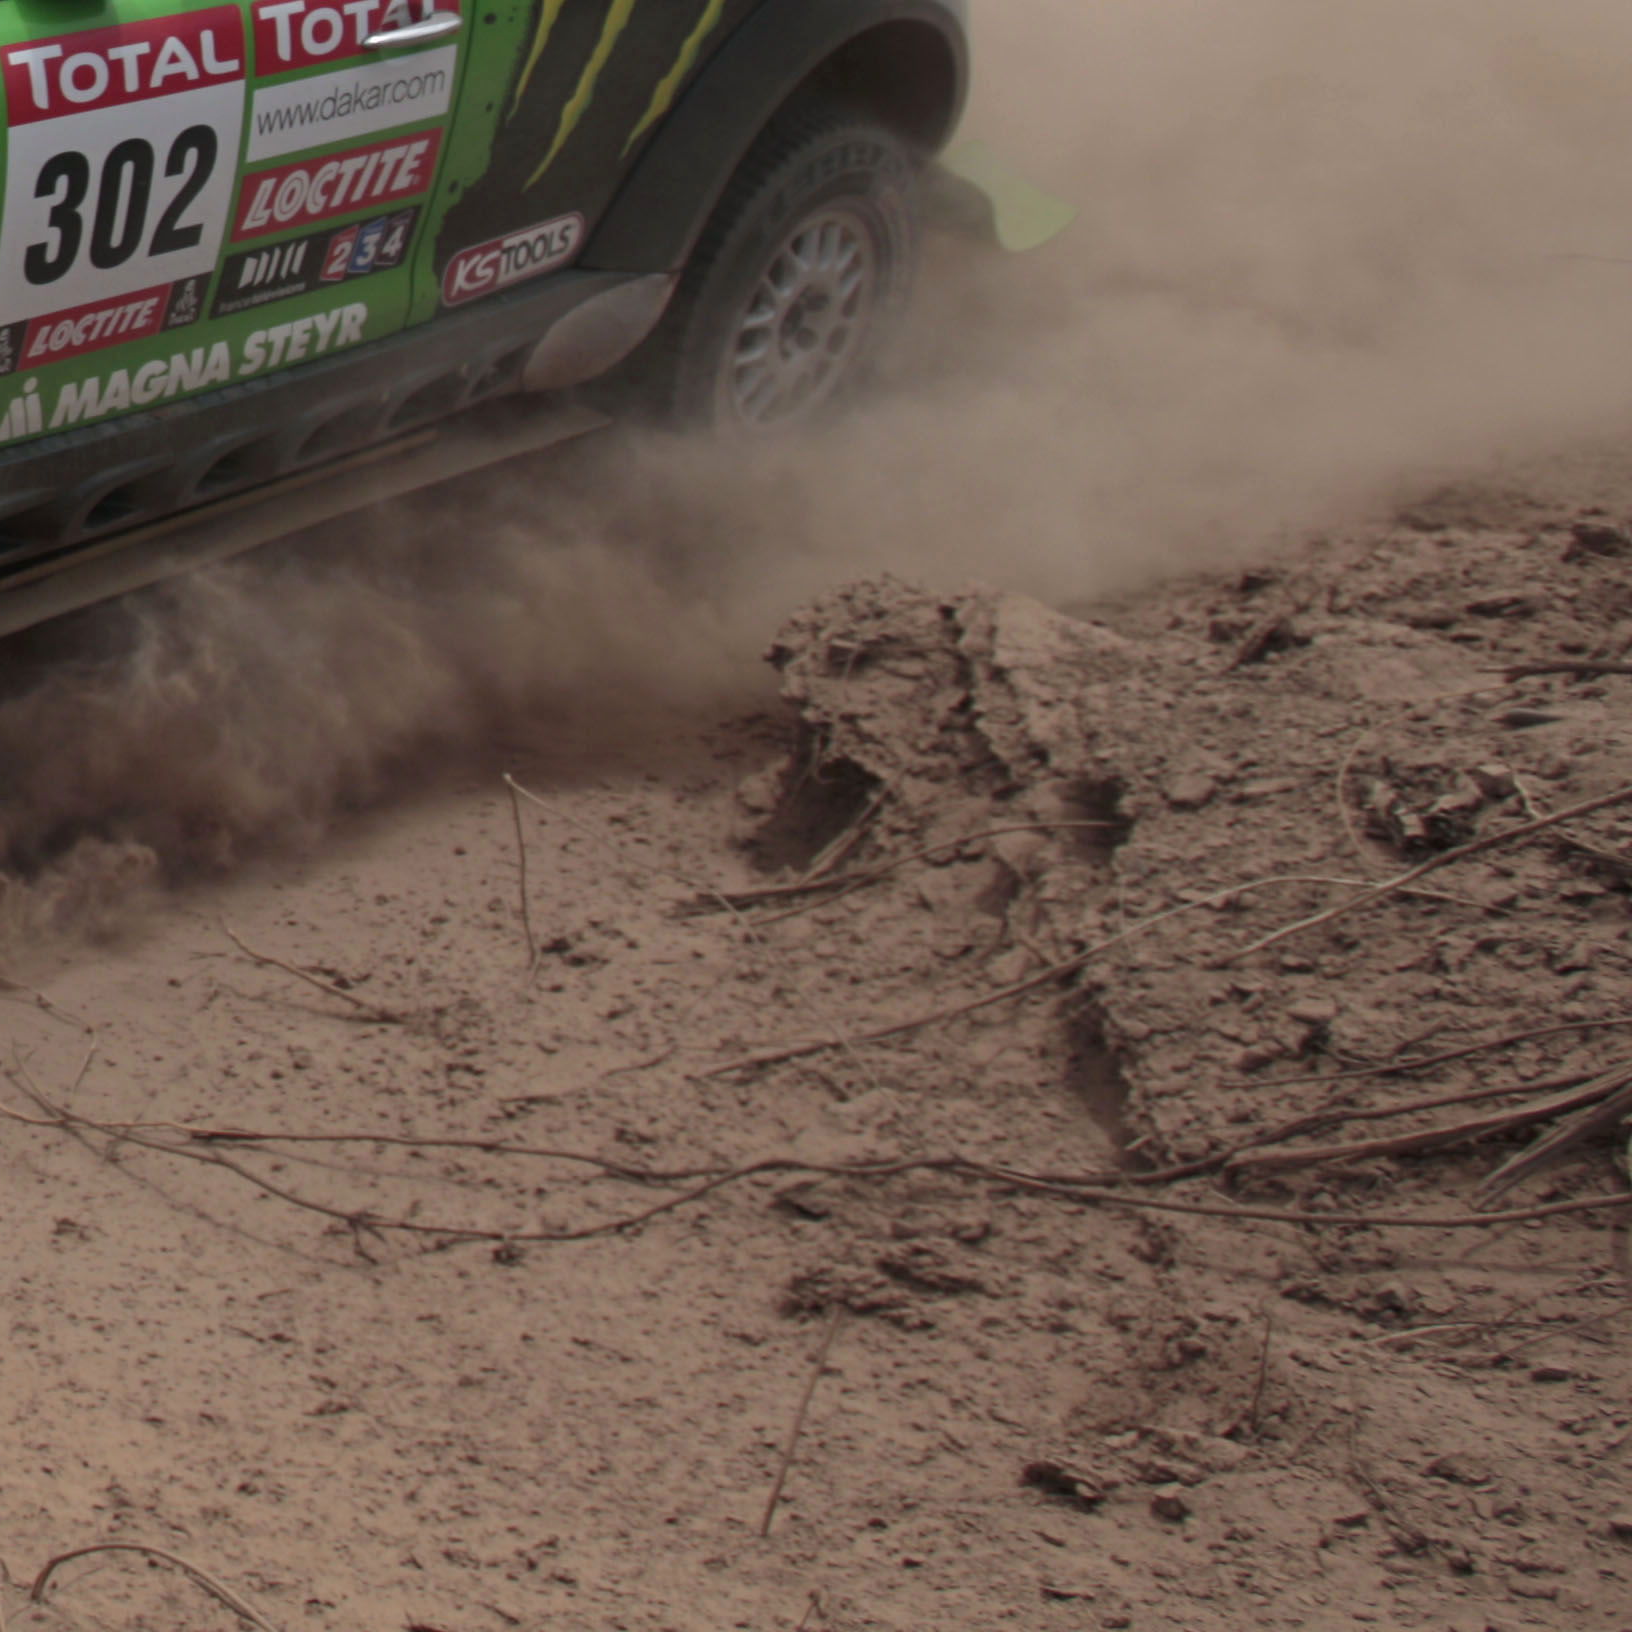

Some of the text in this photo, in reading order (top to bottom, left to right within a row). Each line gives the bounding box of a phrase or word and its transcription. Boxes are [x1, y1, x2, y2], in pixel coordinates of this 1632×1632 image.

[7, 29, 240, 109] TOTAL
[257, 69, 446, 136] www.dakar.com
[23, 124, 218, 285] 302
[241, 139, 430, 231] LOCTITE
[450, 224, 573, 297] KS TOOLS
[27, 297, 160, 358] LOCTITE
[48, 302, 368, 430] MAGNA STEYR
